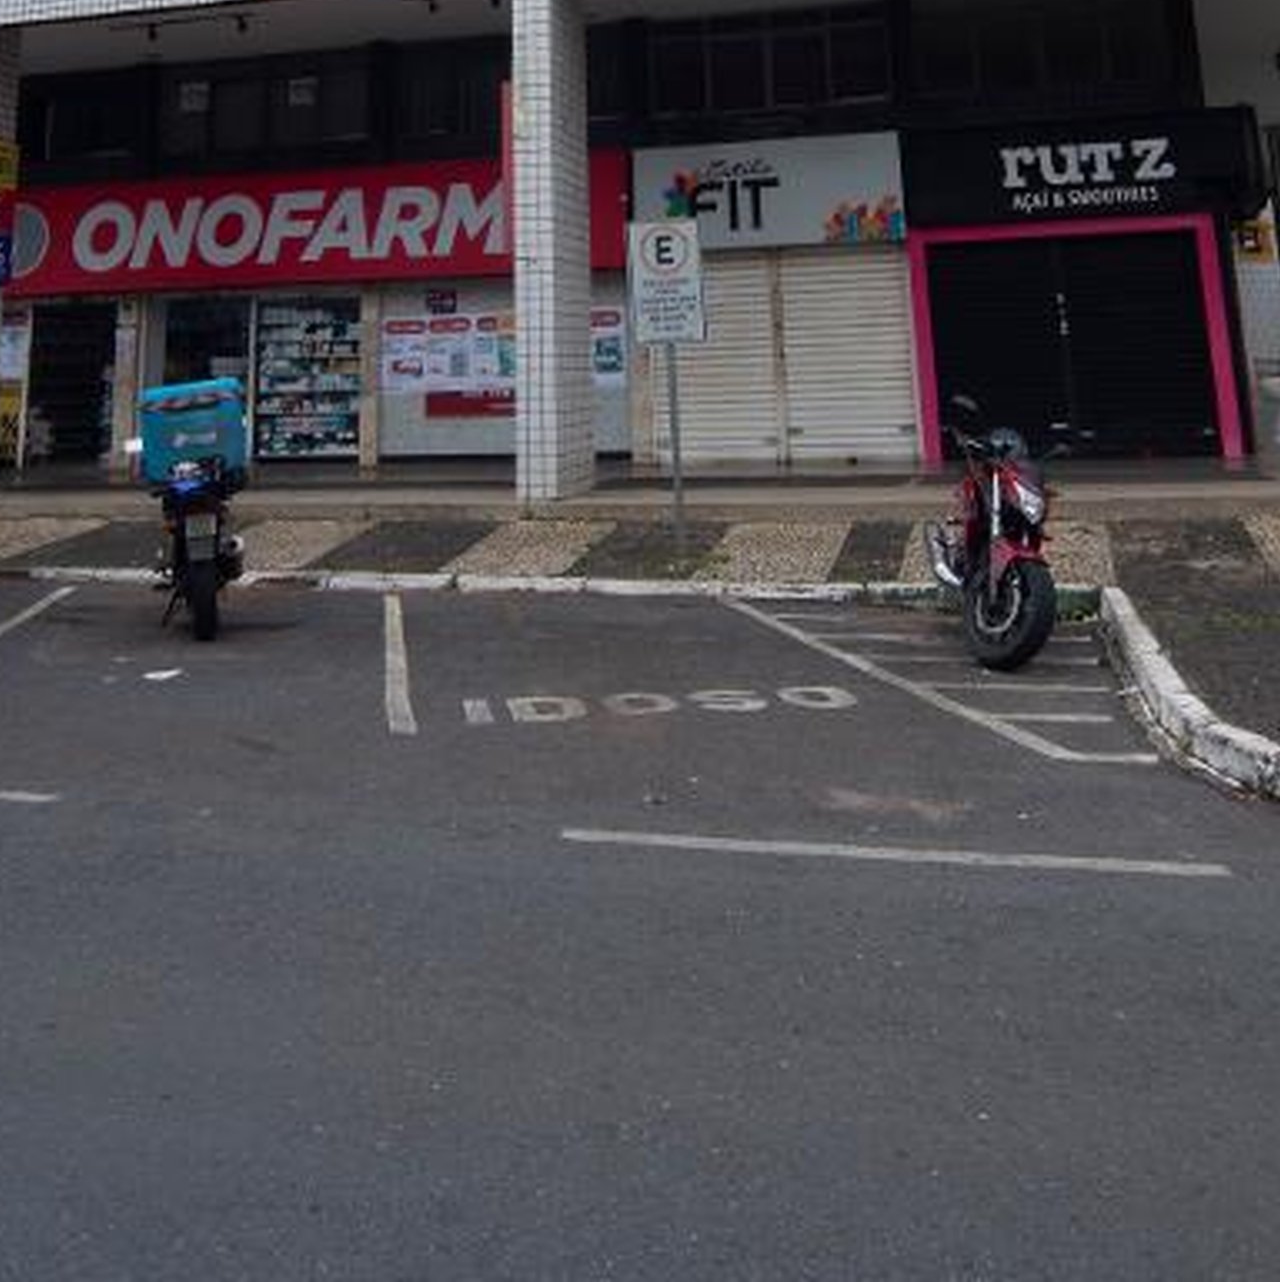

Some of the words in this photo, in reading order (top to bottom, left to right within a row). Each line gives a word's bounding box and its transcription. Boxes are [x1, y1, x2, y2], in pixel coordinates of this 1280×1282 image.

[689, 176, 780, 231] FIT
[655, 235, 676, 265] E
[462, 685, 859, 725] IDOSO
